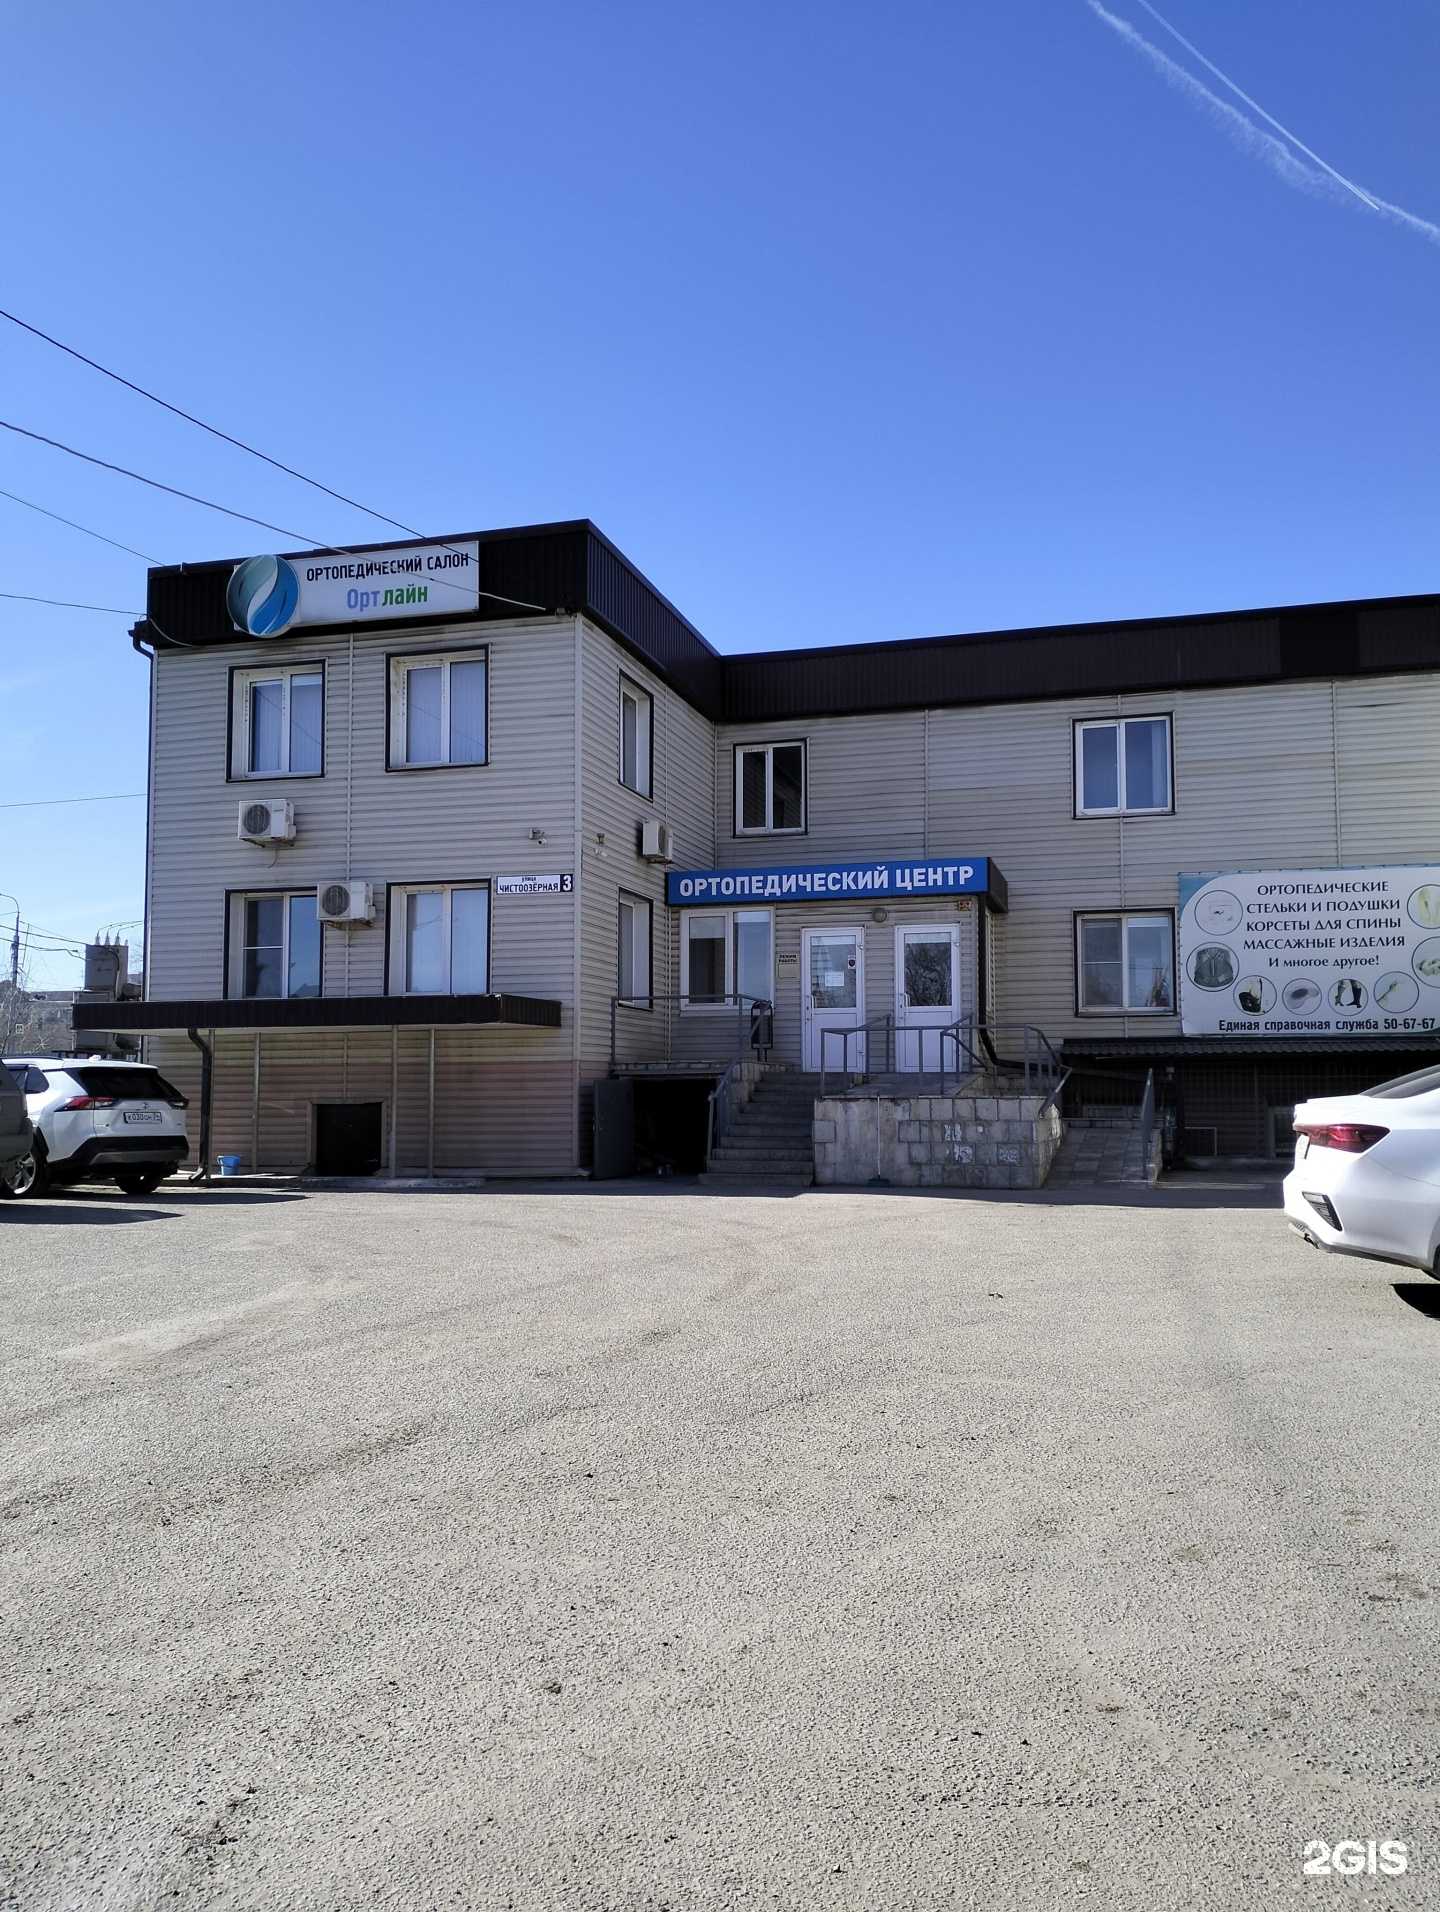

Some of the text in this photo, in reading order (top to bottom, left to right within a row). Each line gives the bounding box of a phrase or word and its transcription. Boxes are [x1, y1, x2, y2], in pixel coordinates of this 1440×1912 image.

[306, 552, 469, 581] ОРТОПЕДИЧЕСКИЙ САЛОН
[563, 875, 571, 891] 3
[679, 865, 974, 897] ОРТОПЕДИЧЕСКИЙ ЦЕНТР
[1257, 881, 1389, 895] ОРТОПЕДИЧЕСКИЕ
[1246, 899, 1400, 914] СТЕЛЬКИ И ПОДУШКИ
[1246, 917, 1401, 932] КОРСЕТЫ ДЛЯ СПИНЫ
[1243, 936, 1405, 950] МАССАЖНЫЕ ИЗДЕЛИЯ
[1269, 955, 1379, 970] И многое другое!
[1219, 1017, 1435, 1032] Единая справочная служба 50-67-67
